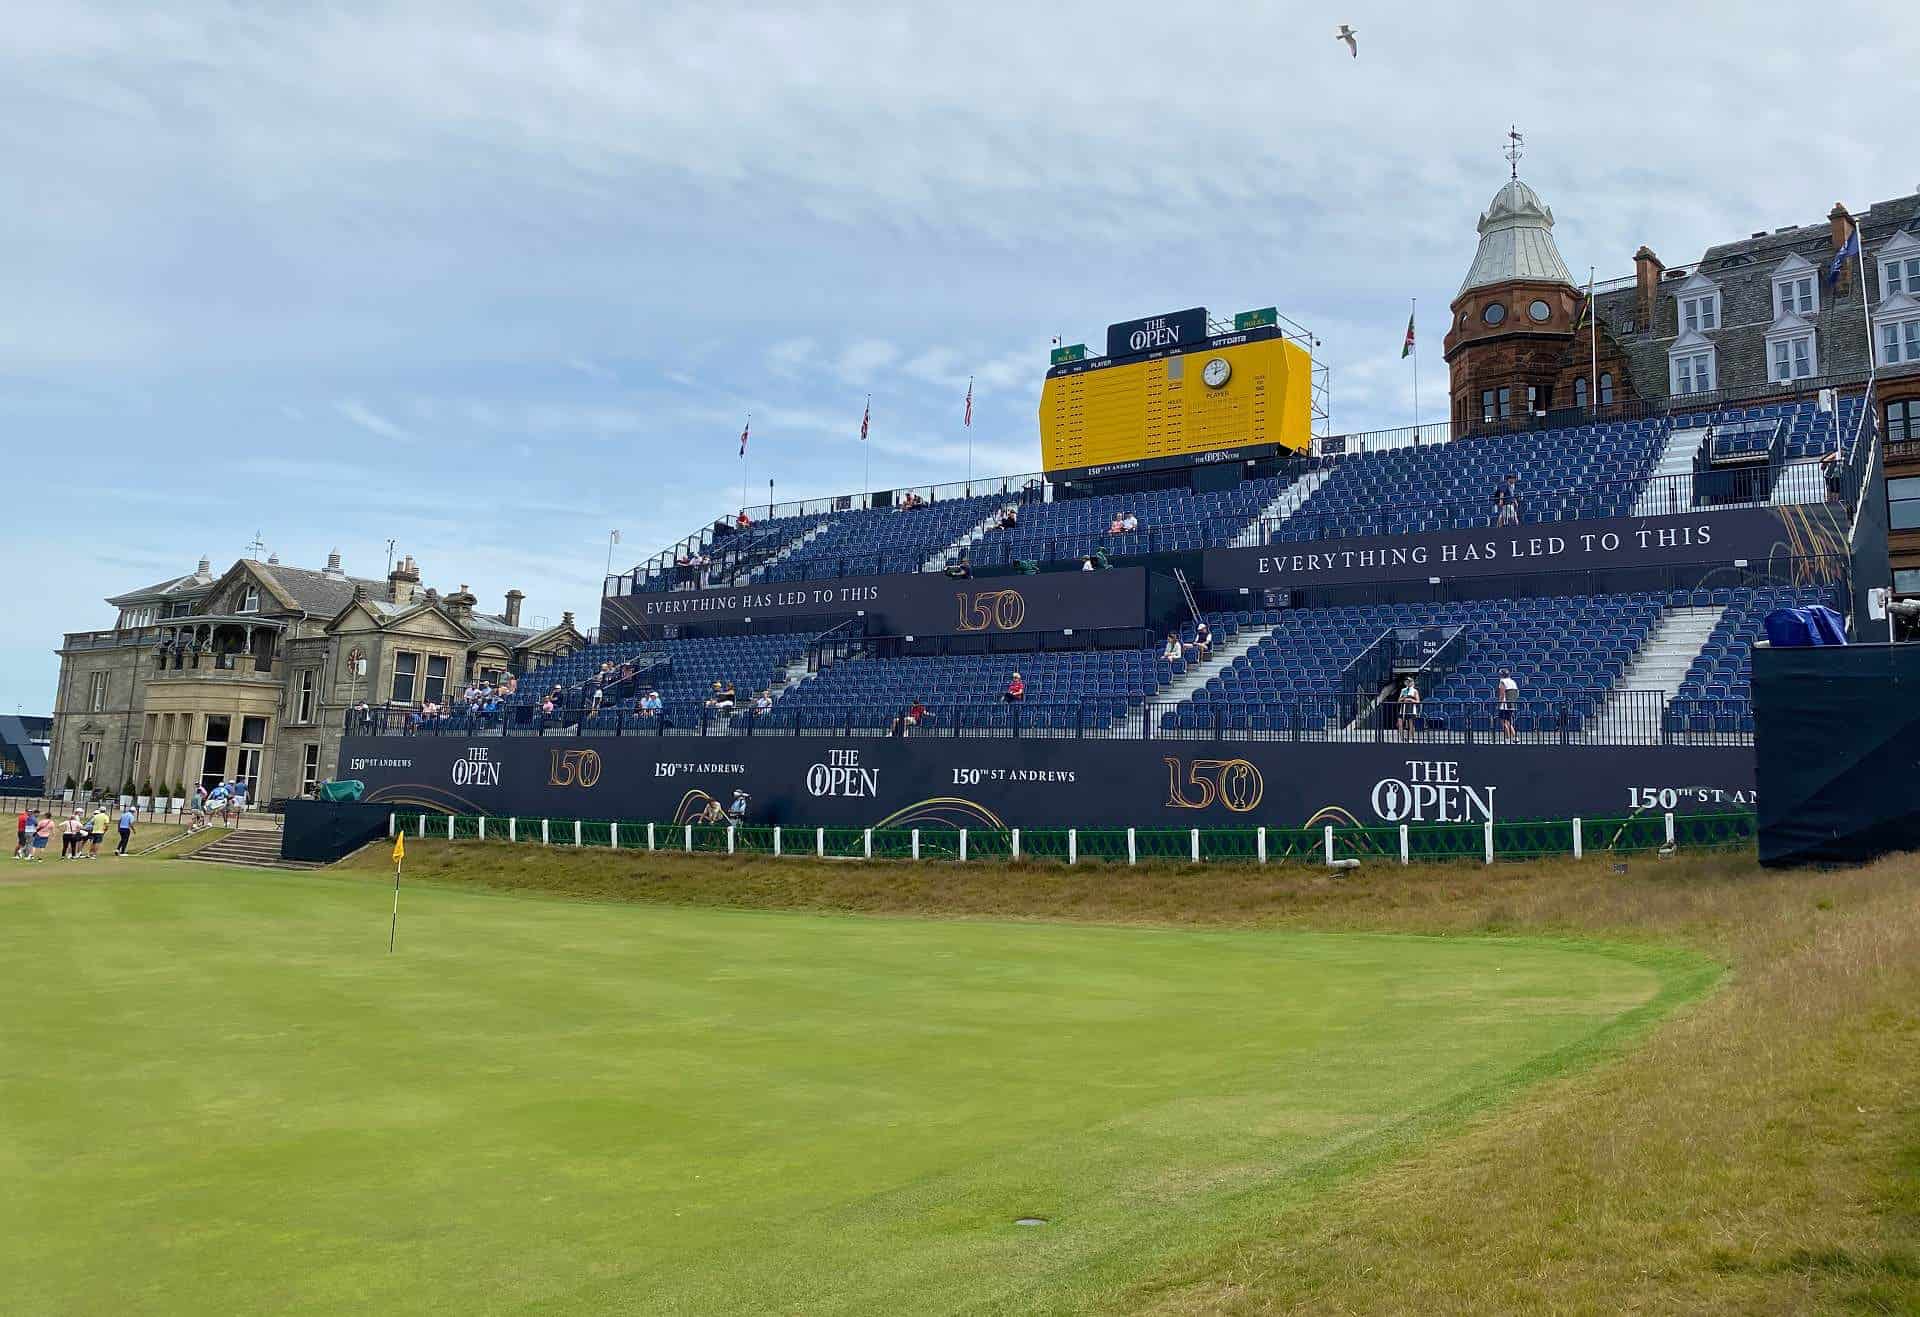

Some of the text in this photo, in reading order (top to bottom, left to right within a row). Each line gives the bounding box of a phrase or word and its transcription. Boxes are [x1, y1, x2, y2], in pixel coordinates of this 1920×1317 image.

[1144, 318, 1166, 331] THE
[1129, 325, 1180, 350] OPEN
[1090, 359, 1112, 369] PLAYER
[1206, 391, 1230, 399] PLAYER
[1258, 525, 1712, 574] EVERYTHING HAS LED TO THIS
[647, 586, 879, 614] EVERYTHING HAS LED TO THIS
[956, 589, 1025, 631] 150
[380, 759, 412, 768] ANDREWS
[468, 747, 489, 761] THE
[829, 749, 859, 767] THE
[452, 758, 503, 786] OPEN
[548, 749, 601, 788] 150
[683, 763, 695, 773] ST
[696, 763, 745, 774] ANDREWS
[990, 769, 1006, 781] ST
[1009, 769, 1076, 783] ANDREWS
[1405, 760, 1460, 783] THE
[806, 763, 879, 798] OPEN
[1161, 754, 1264, 813] 150
[1371, 778, 1497, 823] OPEN
[1698, 789, 1724, 803] ST
